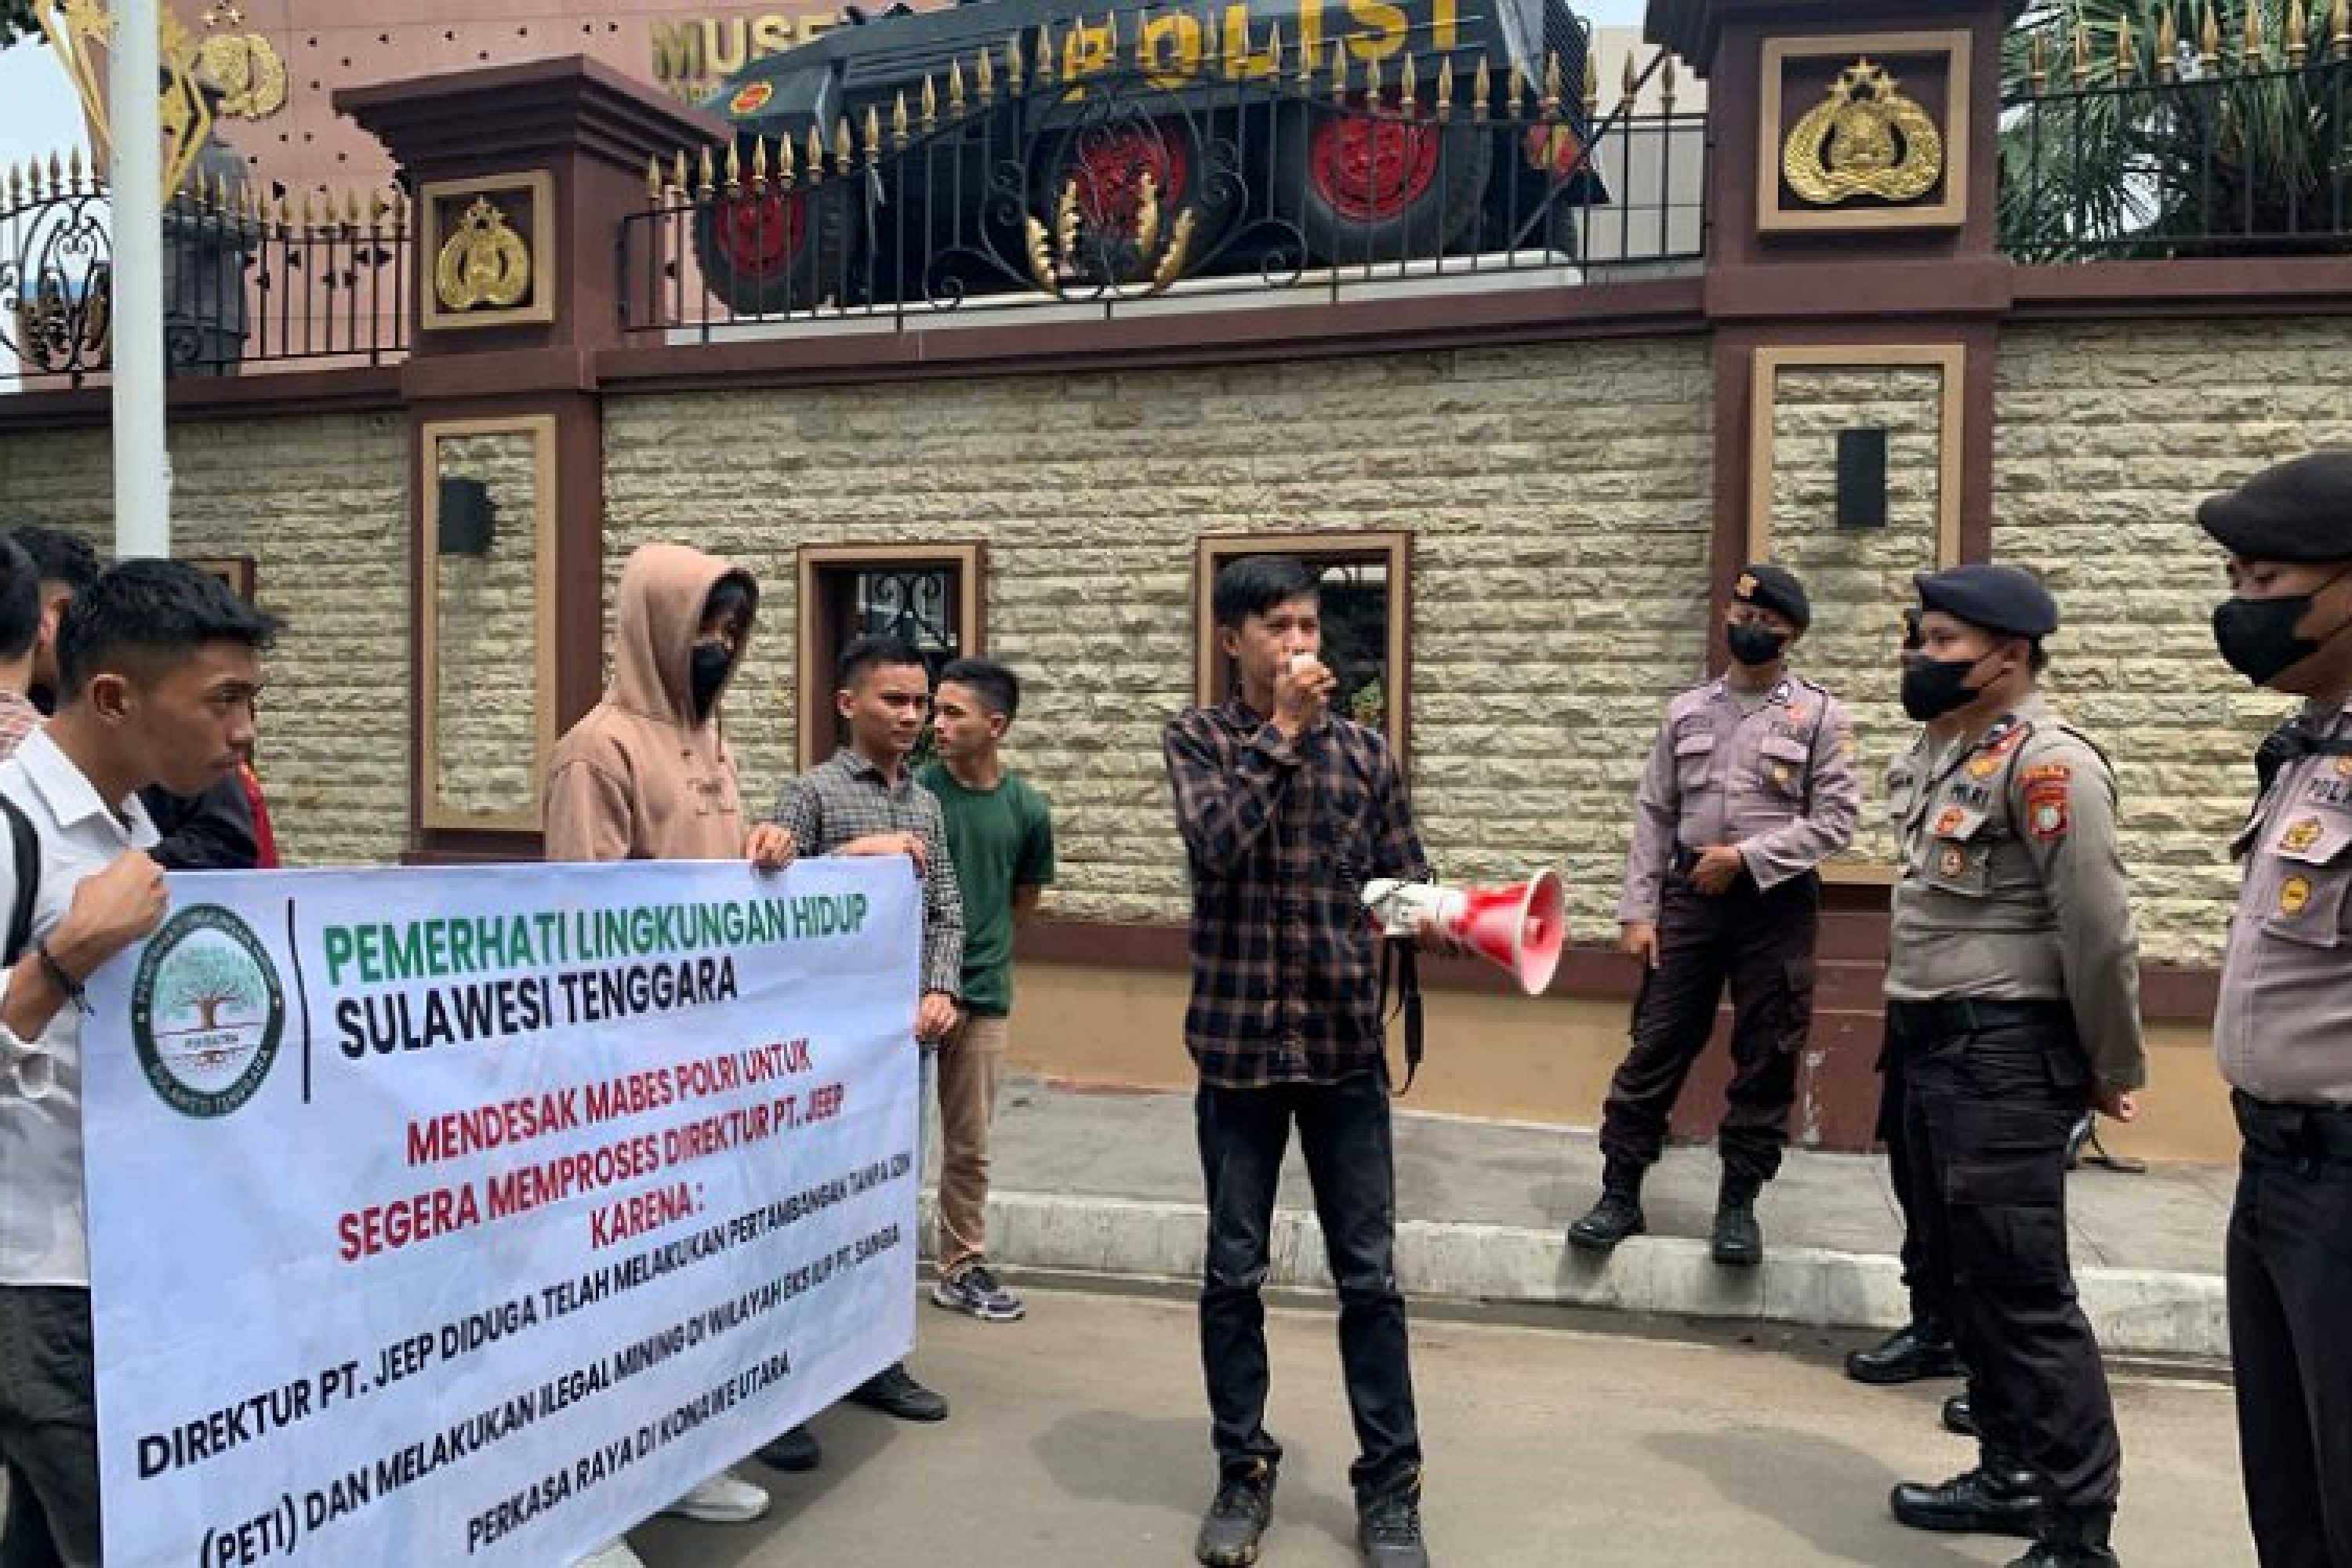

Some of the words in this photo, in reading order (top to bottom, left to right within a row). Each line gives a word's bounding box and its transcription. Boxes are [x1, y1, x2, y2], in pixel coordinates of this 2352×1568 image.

[324, 911, 568, 986] PEMERHATI
[576, 896, 788, 960] LINGKUNGAN
[790, 893, 867, 938] HIDUP
[336, 976, 551, 1059] SULAWESI
[558, 954, 737, 1023] TENGGARA
[338, 1182, 481, 1261] SEGERA
[488, 1134, 659, 1220] MEMPROSES
[664, 1103, 769, 1166] DIREKTUR
[773, 1095, 800, 1134] PT.
[804, 1083, 844, 1123] JEEP
[406, 1089, 578, 1167] MENDESAK
[586, 1069, 673, 1123] MABES
[675, 1052, 740, 1100] POLRI
[741, 1038, 812, 1084] UNTUK
[590, 1181, 695, 1250] KARENA
[138, 1377, 311, 1480] DIREKTUR
[319, 1360, 369, 1409] PT.
[373, 1332, 434, 1388] JEEP
[441, 1294, 537, 1362] DIDUGA
[542, 1267, 609, 1320] TELAH
[614, 1224, 726, 1292] MELAKUKAN
[201, 1493, 298, 1568] (PETI)
[304, 1465, 372, 1532] DAN
[376, 1390, 534, 1497] MELAKUKAN
[539, 1358, 609, 1417] ILEGAL
[614, 1323, 684, 1383] MINING
[686, 1311, 706, 1347] DI
[708, 1279, 782, 1335] WILAYAH
[467, 1467, 572, 1555] PERKASA
[575, 1436, 632, 1493] RAYA
[636, 1422, 656, 1459] DI
[659, 1377, 737, 1444] KONAWE
[739, 1351, 791, 1400] UTARA
